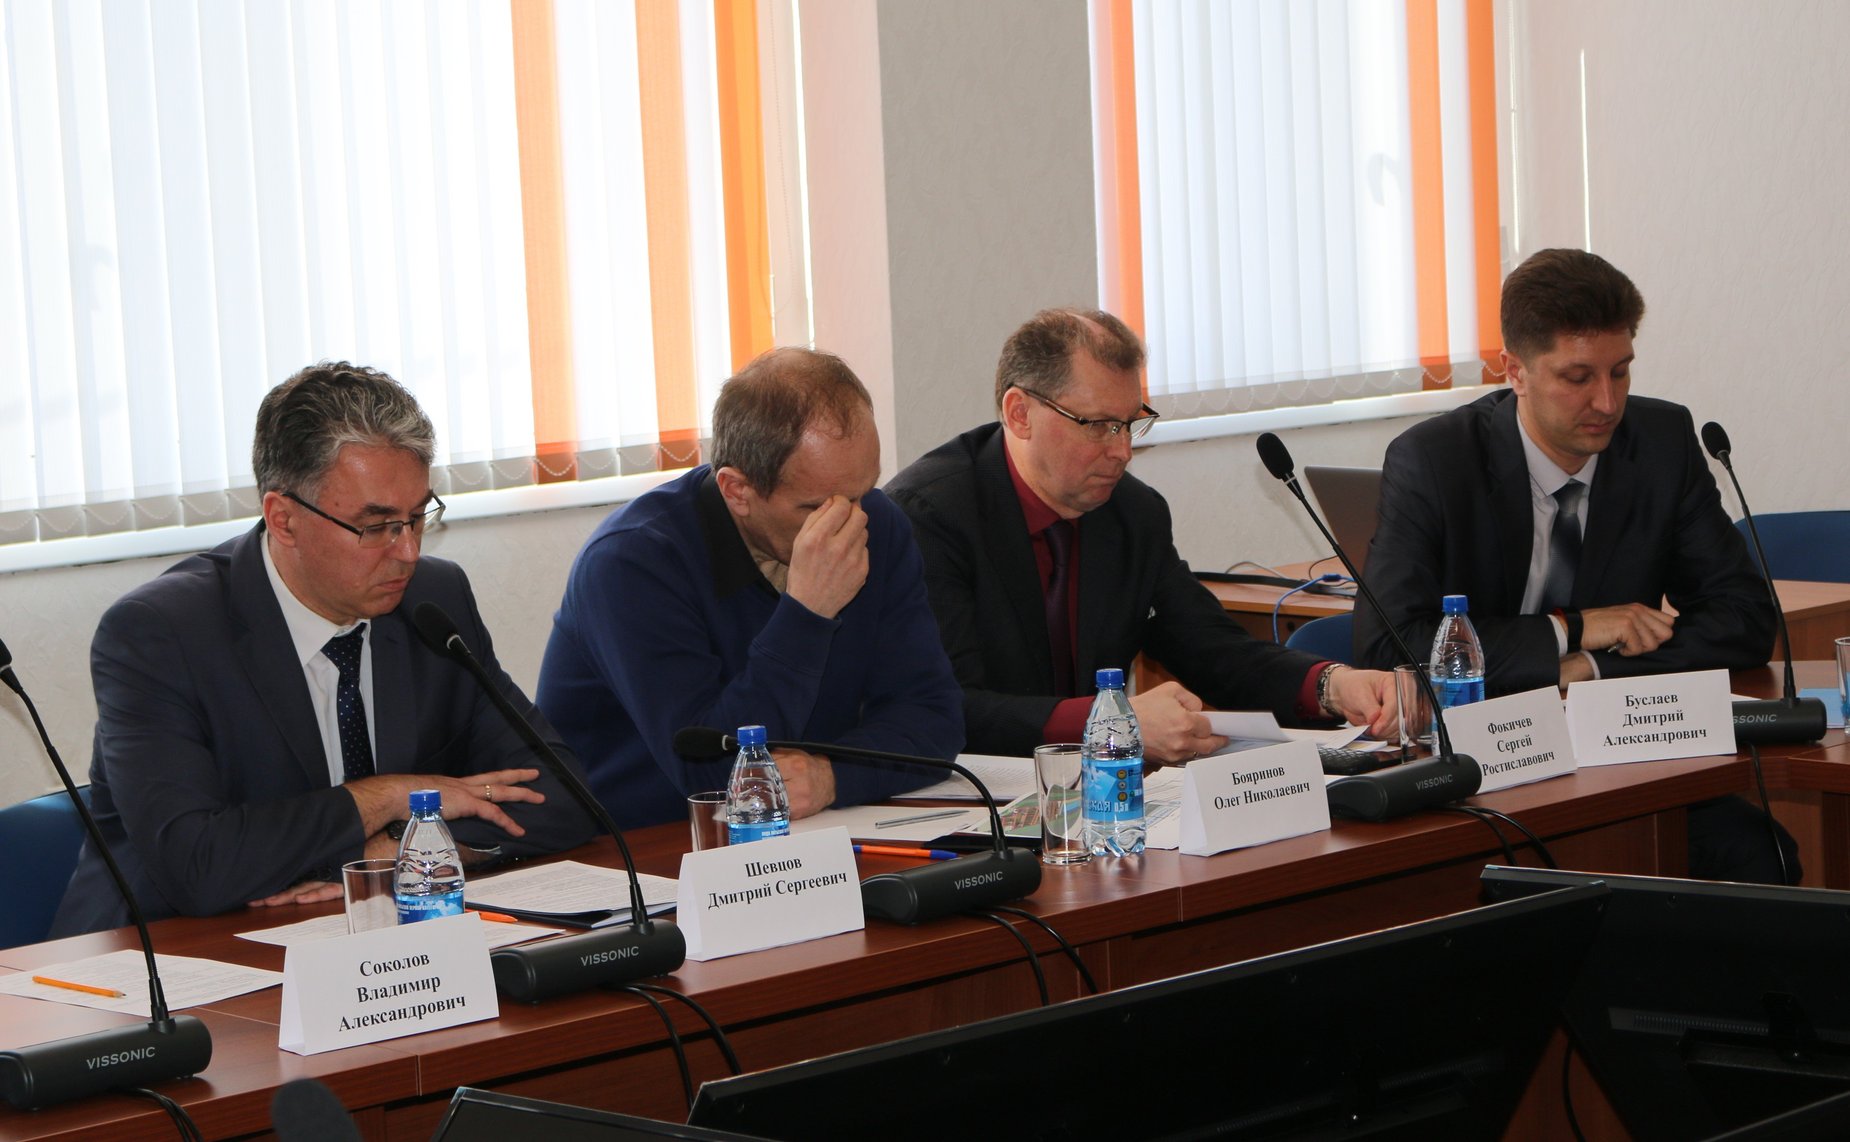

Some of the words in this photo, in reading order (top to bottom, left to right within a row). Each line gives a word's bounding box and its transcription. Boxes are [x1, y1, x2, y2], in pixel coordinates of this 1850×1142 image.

[1625, 694, 1678, 709] Буслаев
[1487, 717, 1533, 735] Фокичев
[1622, 709, 1684, 728] Дмитрий
[1732, 714, 1777, 724] SSONIC
[1497, 734, 1533, 753] Сергей
[1603, 728, 1707, 747] Александрович
[1482, 751, 1555, 776] Ростиславович
[1231, 766, 1285, 786] Бояринов
[1415, 774, 1453, 790] VISSONIC
[1214, 795, 1241, 810] Олег
[1243, 782, 1311, 804] Николаевич
[745, 858, 802, 878] Шевцов
[708, 883, 772, 910] Дмитрий
[775, 872, 848, 896] Сергеевич
[954, 871, 1004, 891] VISSONIC
[360, 954, 431, 977] Соколов
[580, 946, 640, 967] VISSONIC
[356, 976, 442, 1003] Владимир
[339, 996, 467, 1032] Александрович
[86, 1046, 156, 1070] VISSONIC
